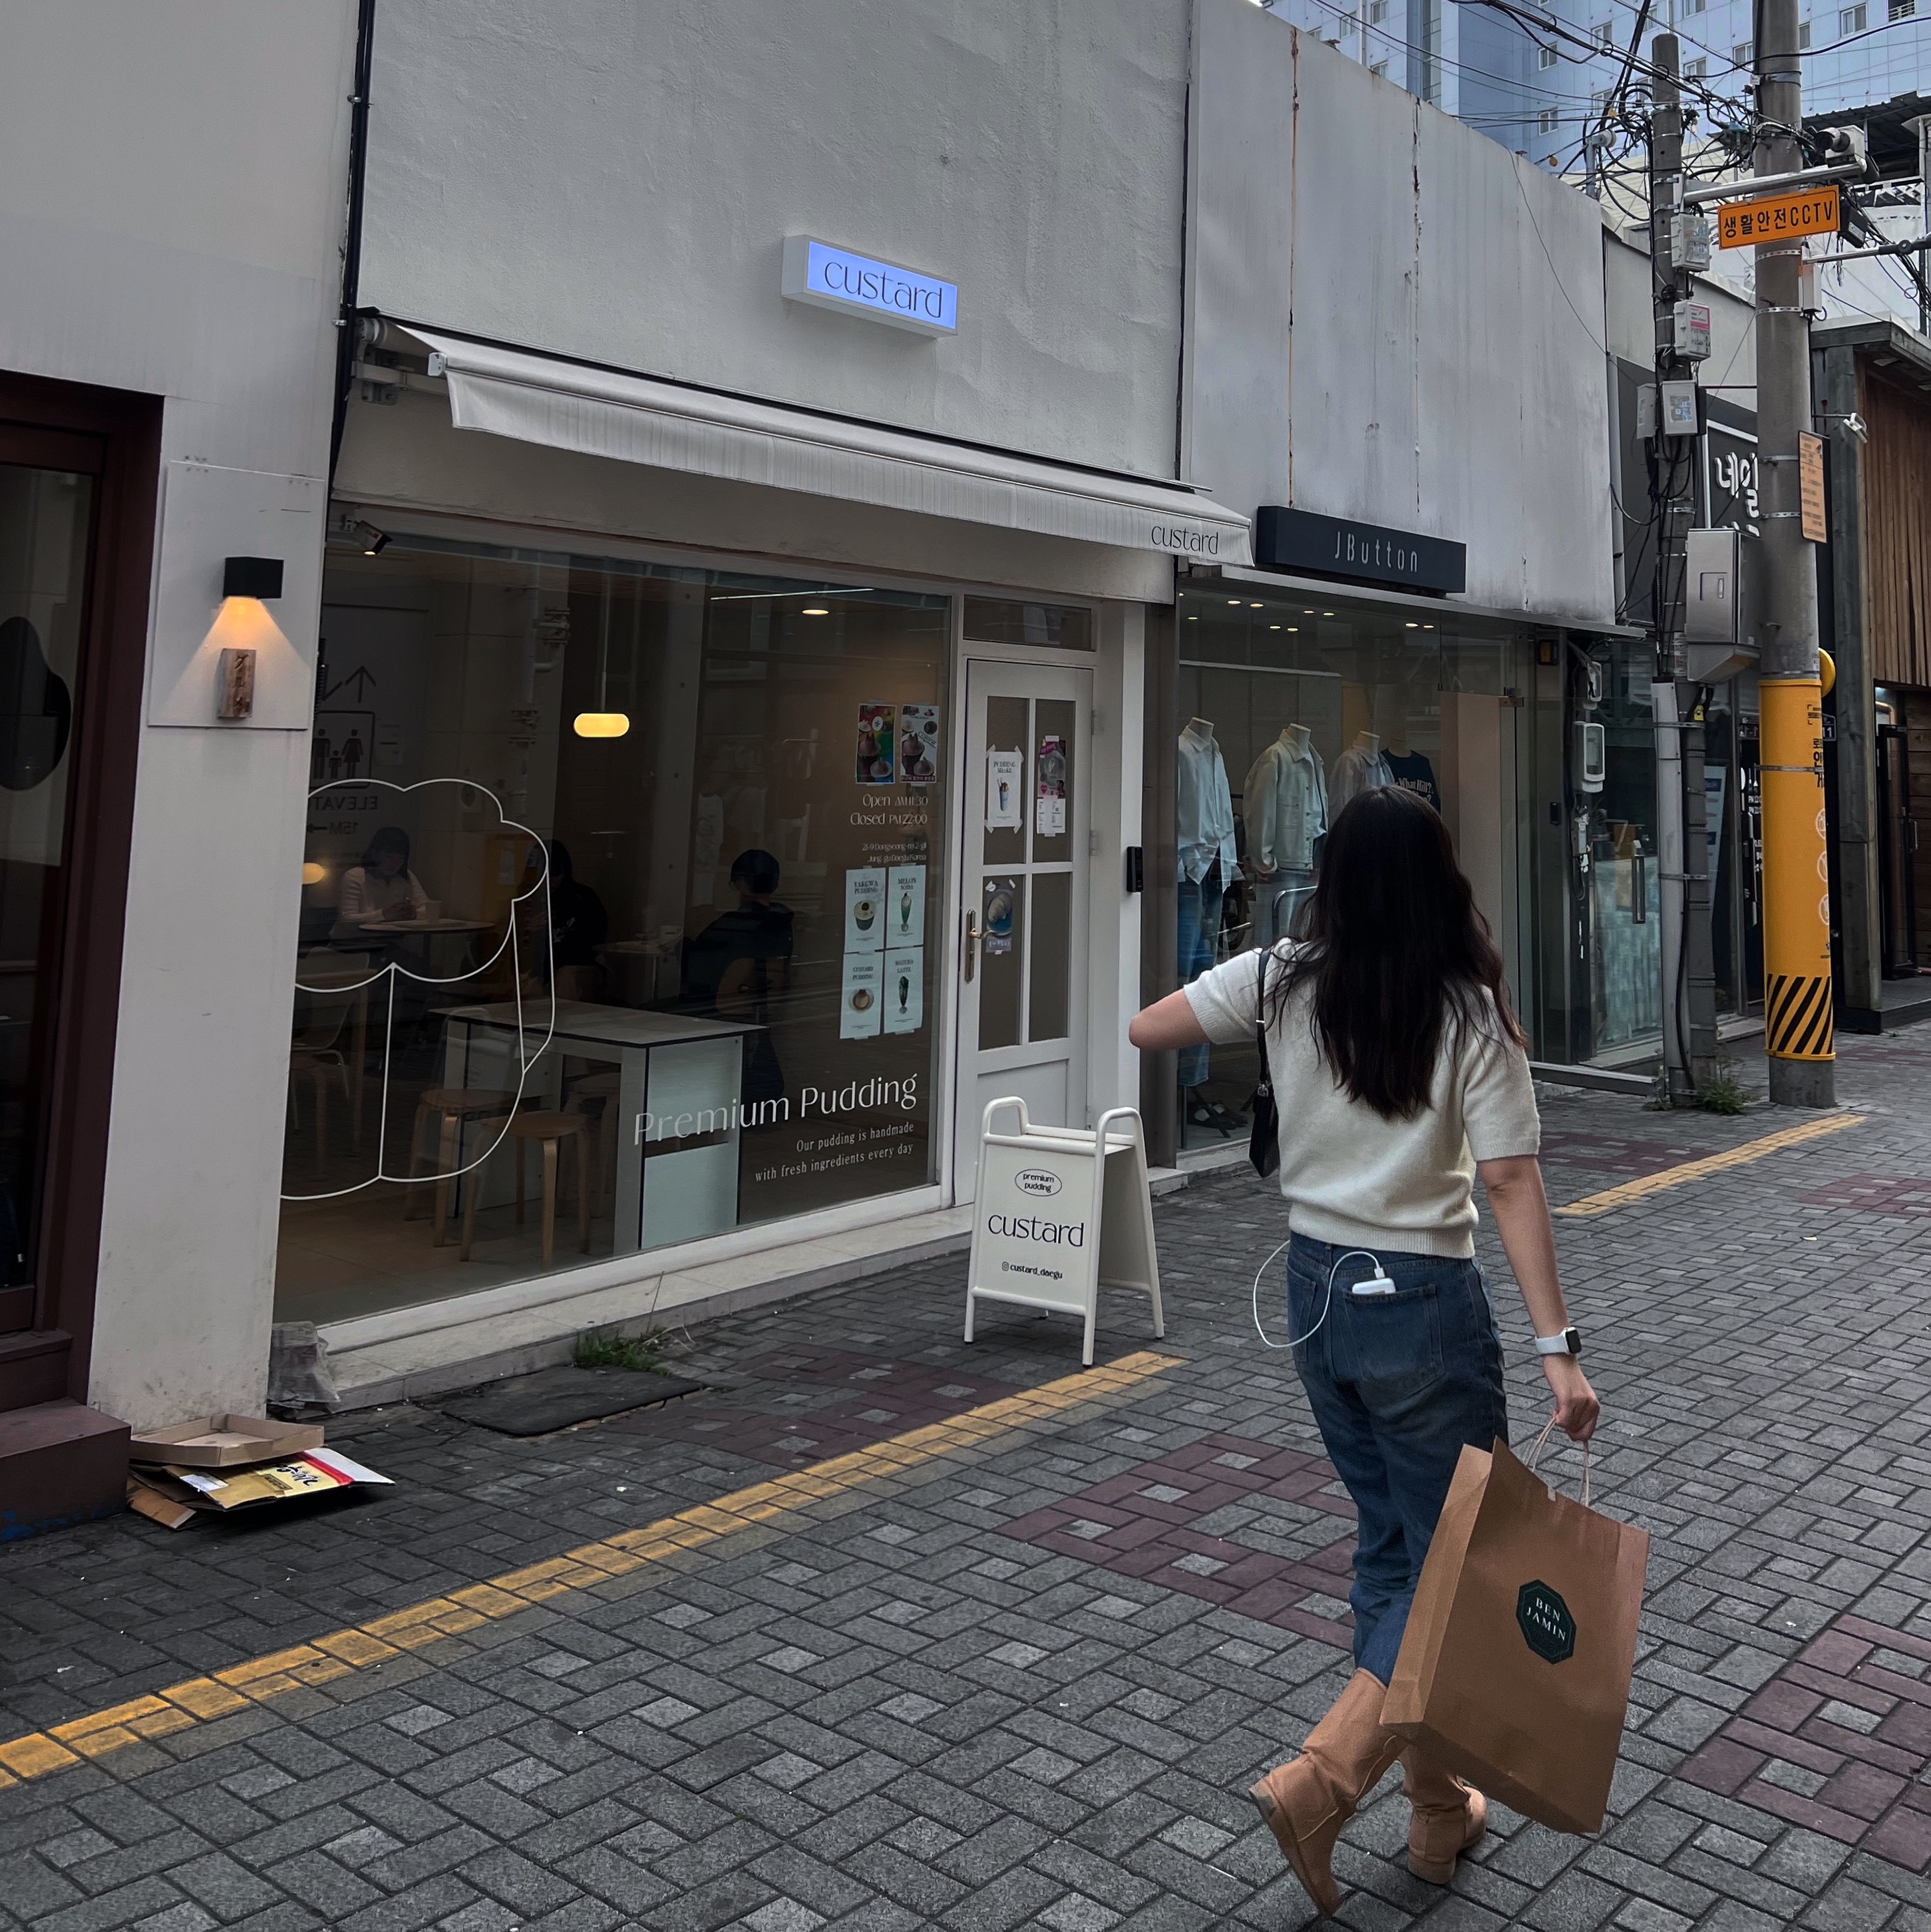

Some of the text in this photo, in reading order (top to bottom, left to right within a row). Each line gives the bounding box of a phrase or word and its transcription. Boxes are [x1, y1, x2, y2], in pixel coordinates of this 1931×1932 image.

[1723, 200, 1833, 238] 생활안전CCTV
[824, 261, 942, 318] custard
[1150, 525, 1218, 555] custard
[862, 793, 890, 808] Open
[850, 812, 885, 825] Closed
[633, 1073, 918, 1146] Premium Pudding
[796, 1121, 914, 1152] Our pudding is handmade
[755, 1142, 914, 1182] with fresh ingredients every day
[1023, 1173, 1055, 1183] premium
[1024, 1182, 1052, 1193] pudding
[988, 1214, 1084, 1247] custard
[1526, 1607, 1566, 1641] JAMIN
[1536, 1597, 1560, 1623] BEN
